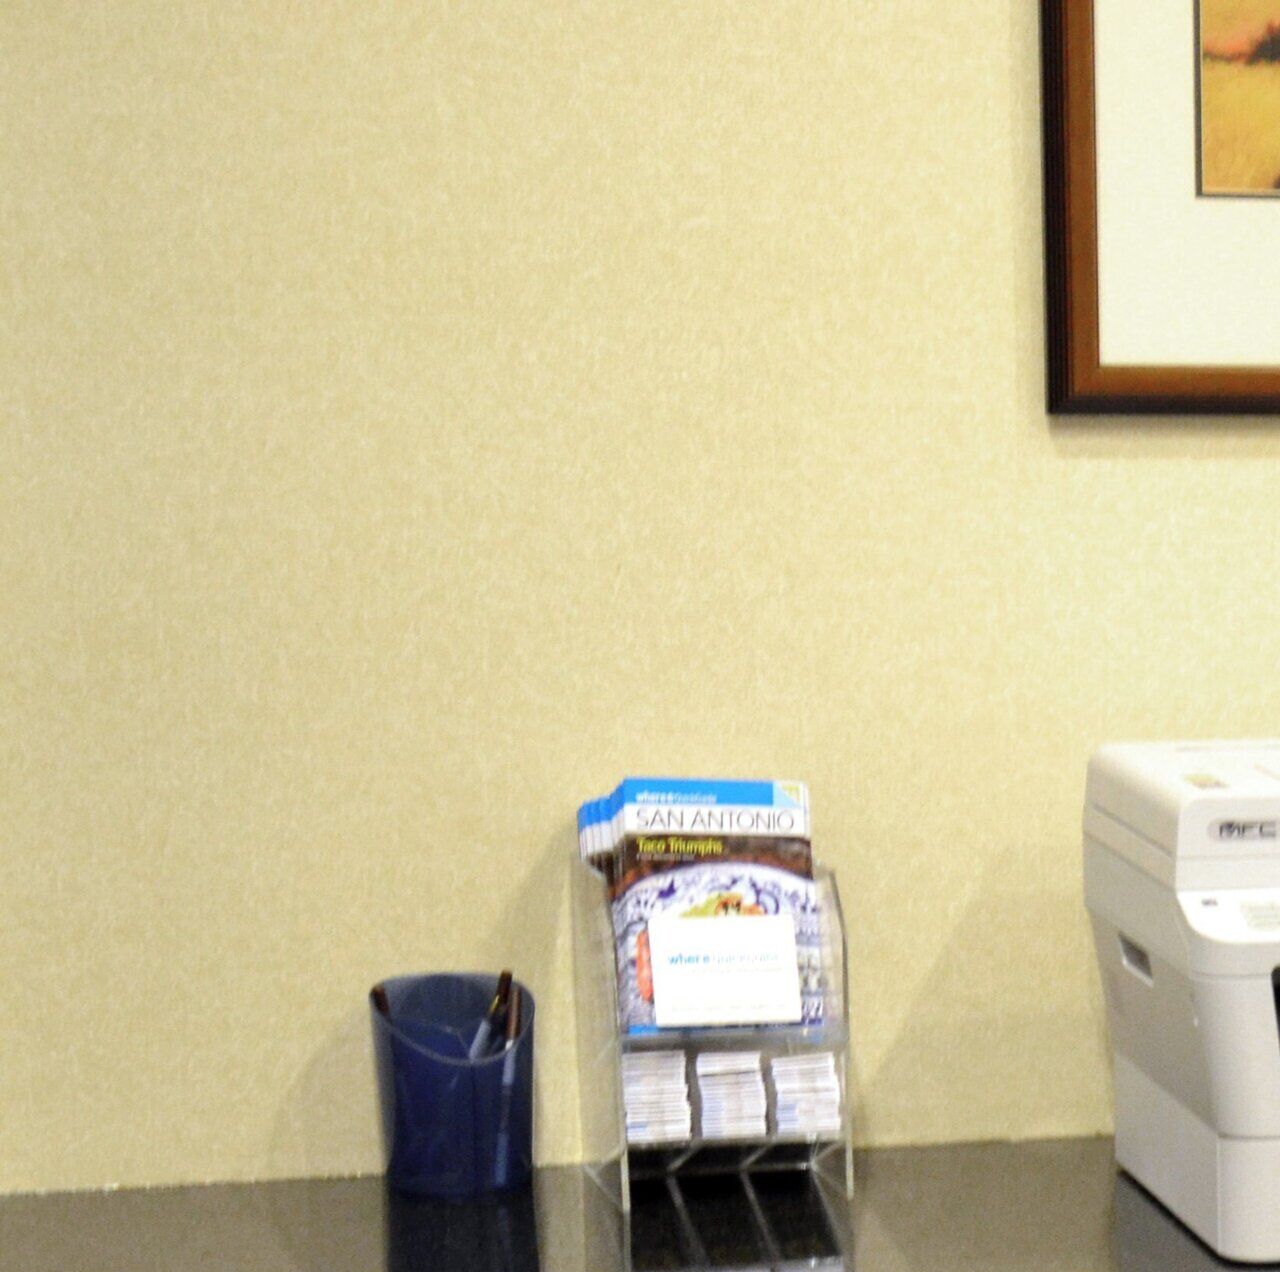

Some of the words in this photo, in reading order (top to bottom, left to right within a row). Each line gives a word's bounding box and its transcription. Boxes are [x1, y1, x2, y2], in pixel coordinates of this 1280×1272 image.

[636, 808, 684, 830] SAN
[690, 808, 795, 831] ANTONIO
[1219, 820, 1277, 838] MFC
[637, 836, 666, 855] Taco
[668, 836, 723, 858] Triumphs
